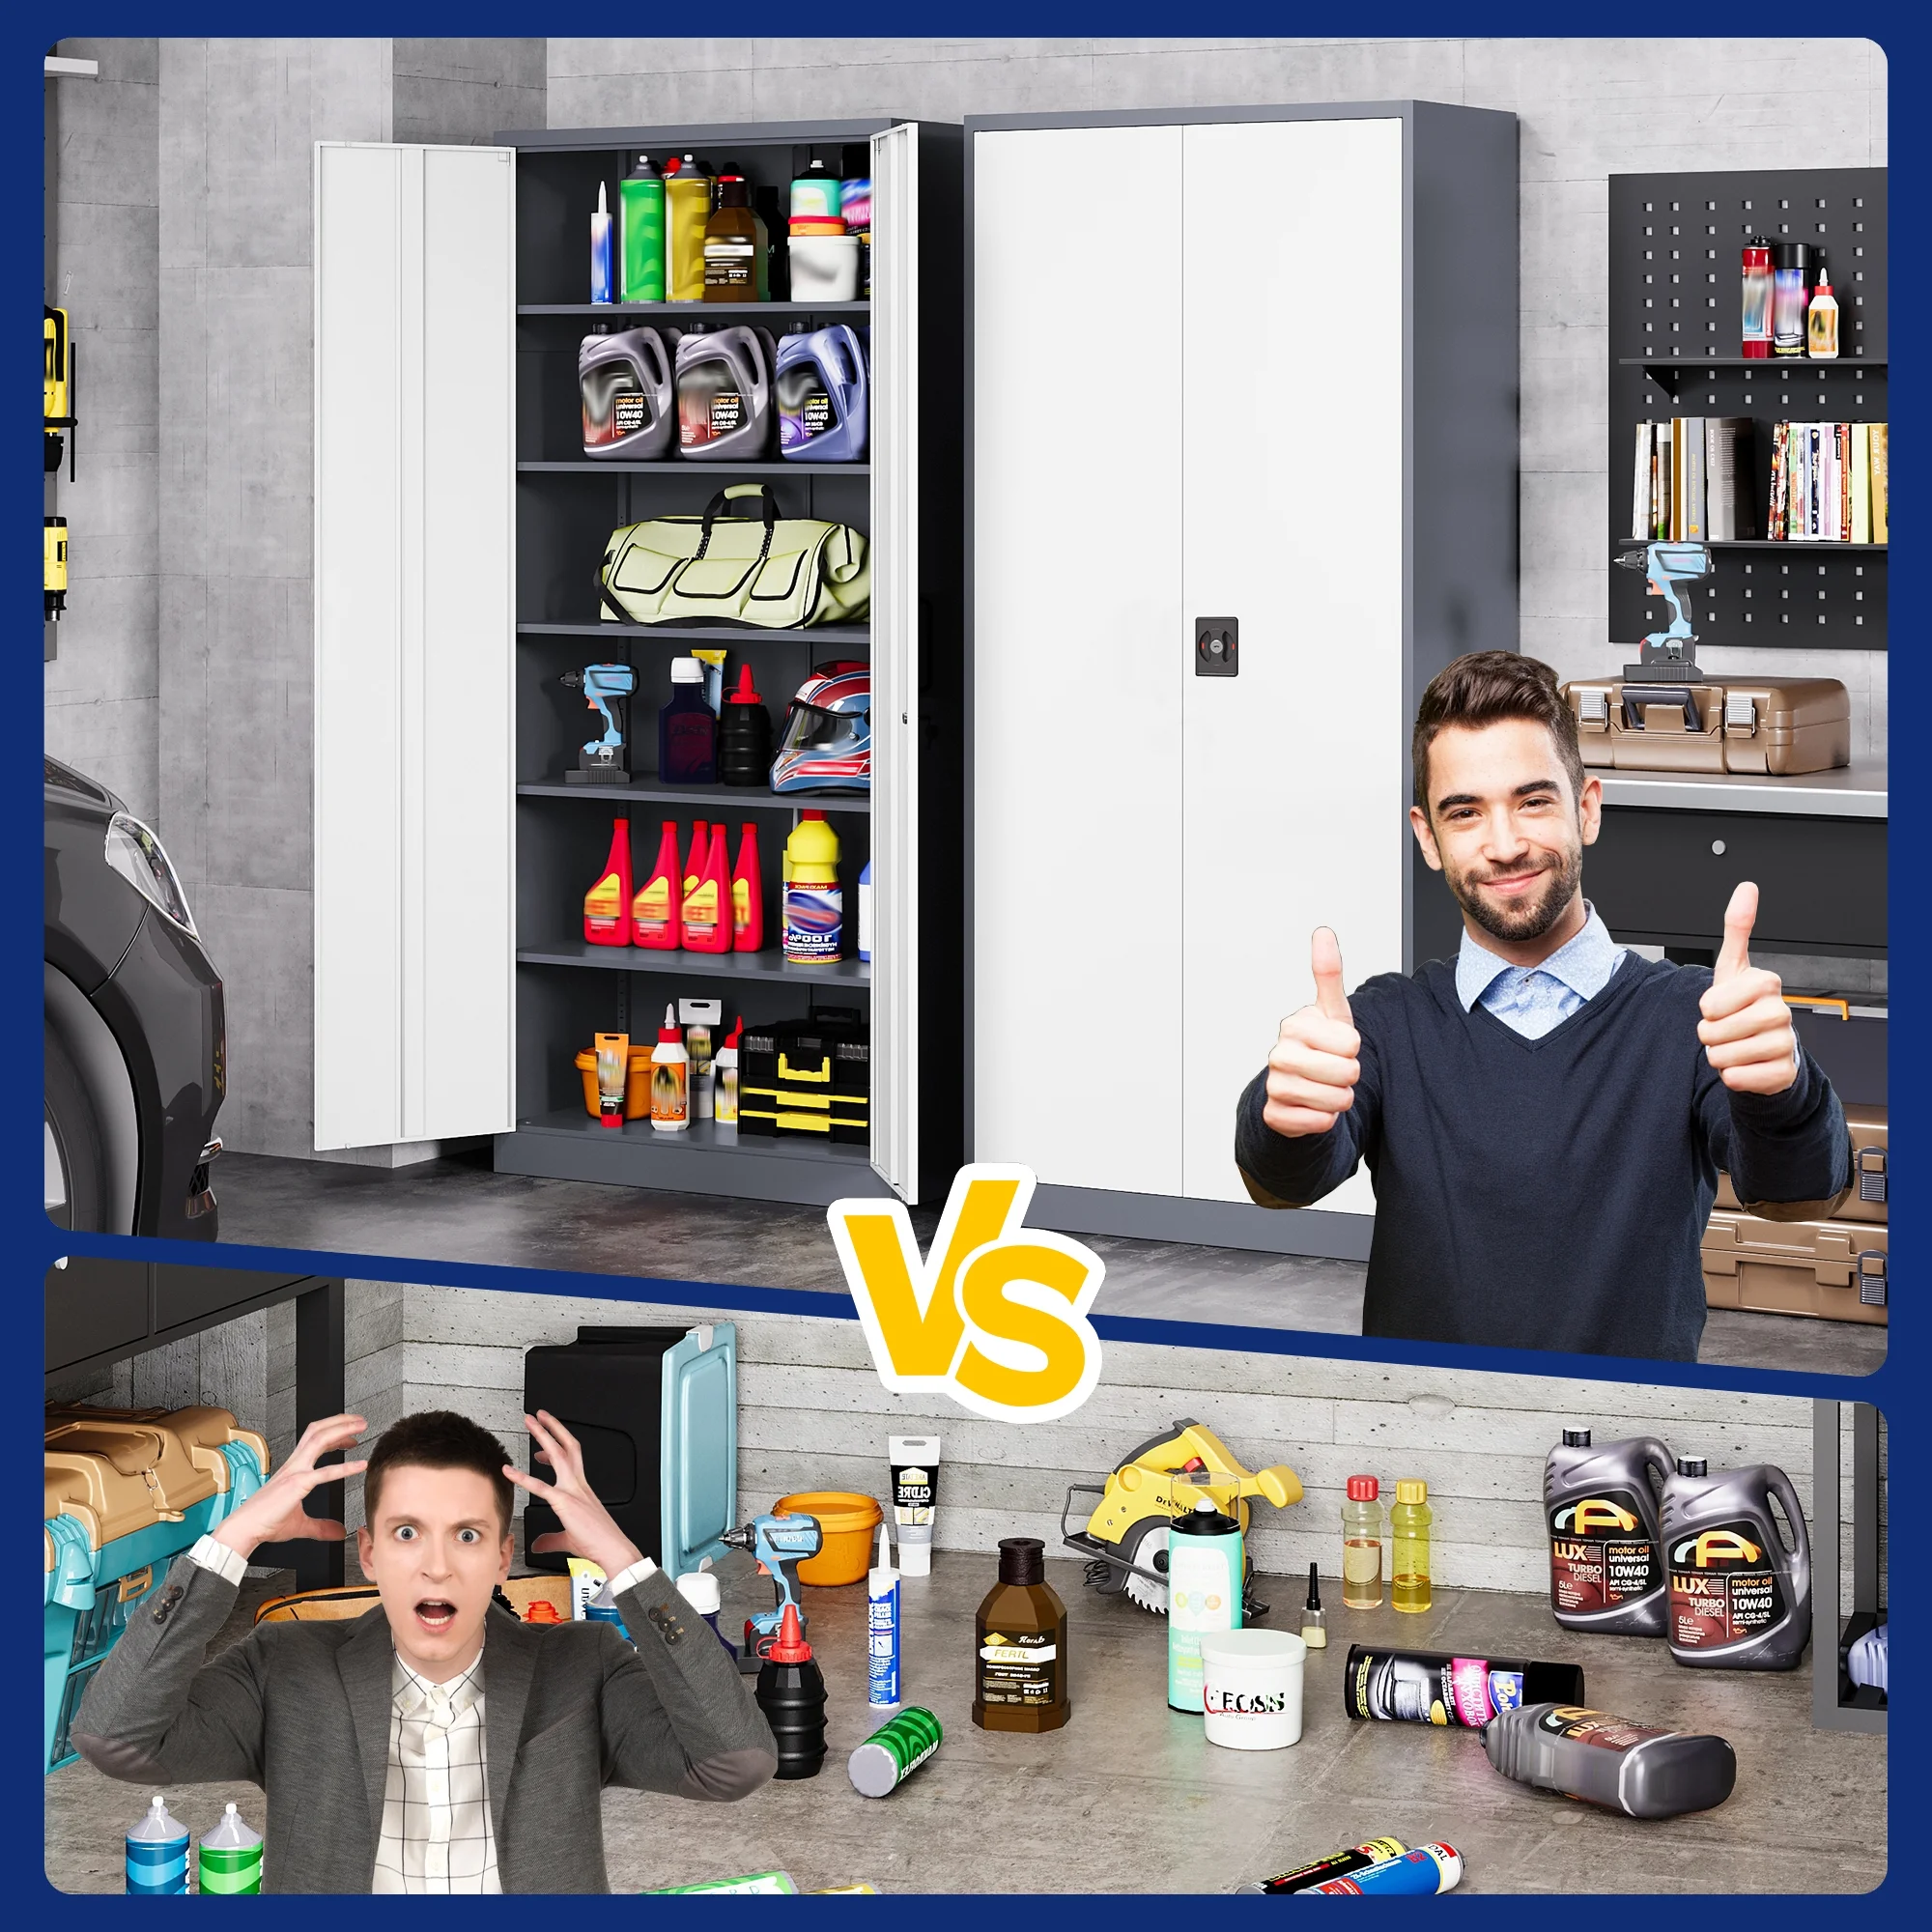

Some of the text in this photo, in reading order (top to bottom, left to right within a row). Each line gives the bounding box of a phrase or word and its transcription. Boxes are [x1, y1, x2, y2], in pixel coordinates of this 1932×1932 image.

[615, 411, 643, 419] 10W40
[712, 411, 739, 419] 10W40
[805, 412, 829, 420] 10W40
[1553, 1542, 1588, 1561] LUX
[1608, 1554, 1649, 1563] universal
[1568, 1563, 1603, 1574] TURBO
[1608, 1565, 1649, 1577] 10W40
[1574, 1574, 1602, 1582] DIESEL
[1672, 1576, 1710, 1595] LUX
[1732, 1586, 1773, 1596] universal
[1689, 1597, 1724, 1607] TURBO
[1732, 1597, 1773, 1610] 10W40
[1694, 1607, 1724, 1617] DIESEL
